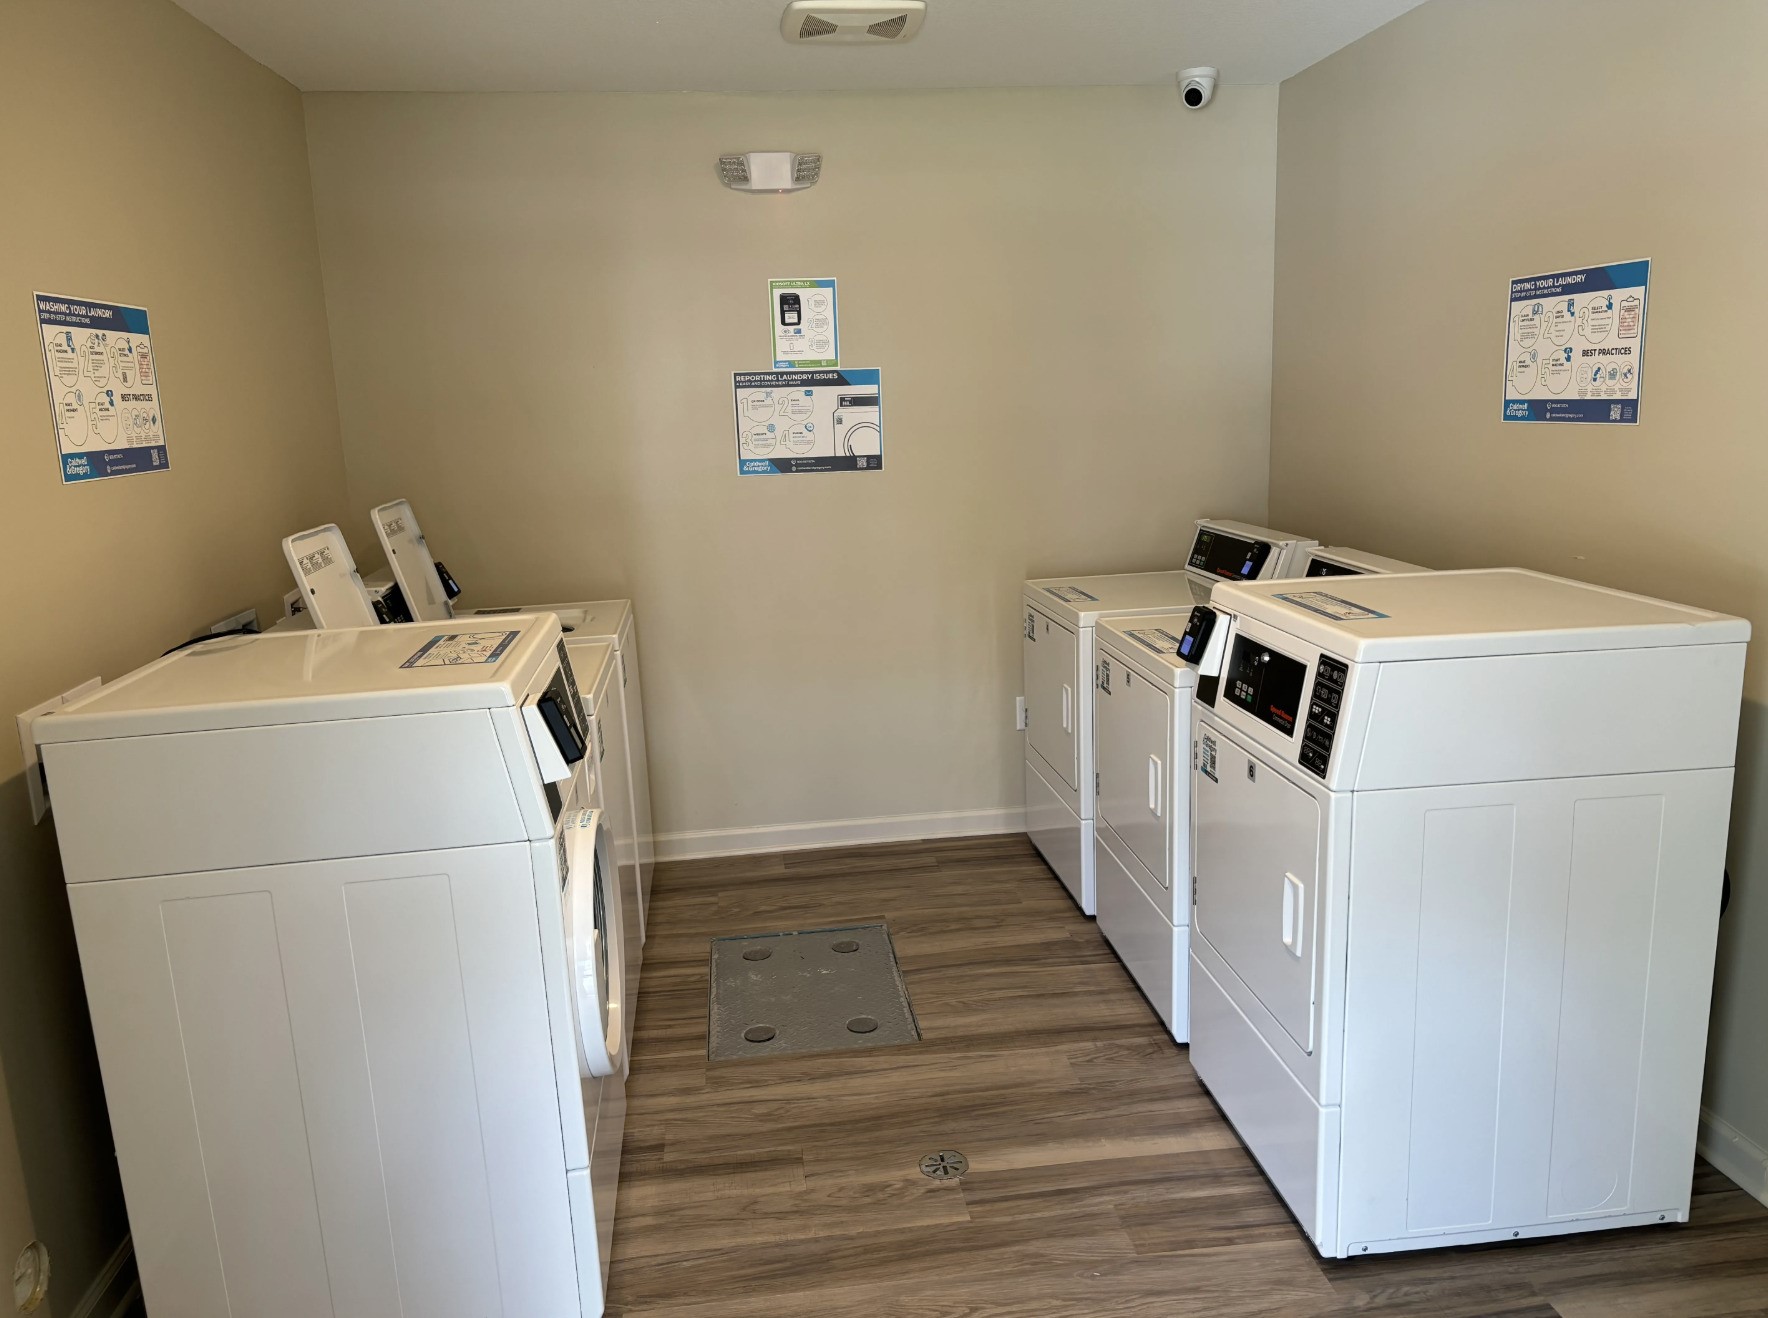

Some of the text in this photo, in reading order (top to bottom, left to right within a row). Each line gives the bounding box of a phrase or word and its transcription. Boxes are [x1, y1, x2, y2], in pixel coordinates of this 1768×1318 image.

[1512, 274, 1587, 292] DRYING YOUR LAUNDRY
[1536, 287, 1562, 296] INSTRUCTIONS
[39, 301, 113, 319] WASHING YOUR LAUNDRY
[40, 313, 91, 324] STEP-BY-STEP INSTRUCTIONS
[1582, 347, 1632, 357] BEST PRACTICES
[736, 374, 777, 382] REPORTING
[813, 372, 838, 380] ISSUES
[121, 393, 153, 402] BEST PRACTICES
[1509, 402, 1528, 410] Caldwell
[67, 457, 87, 466] Caldwell
[1249, 765, 1254, 778] 6
